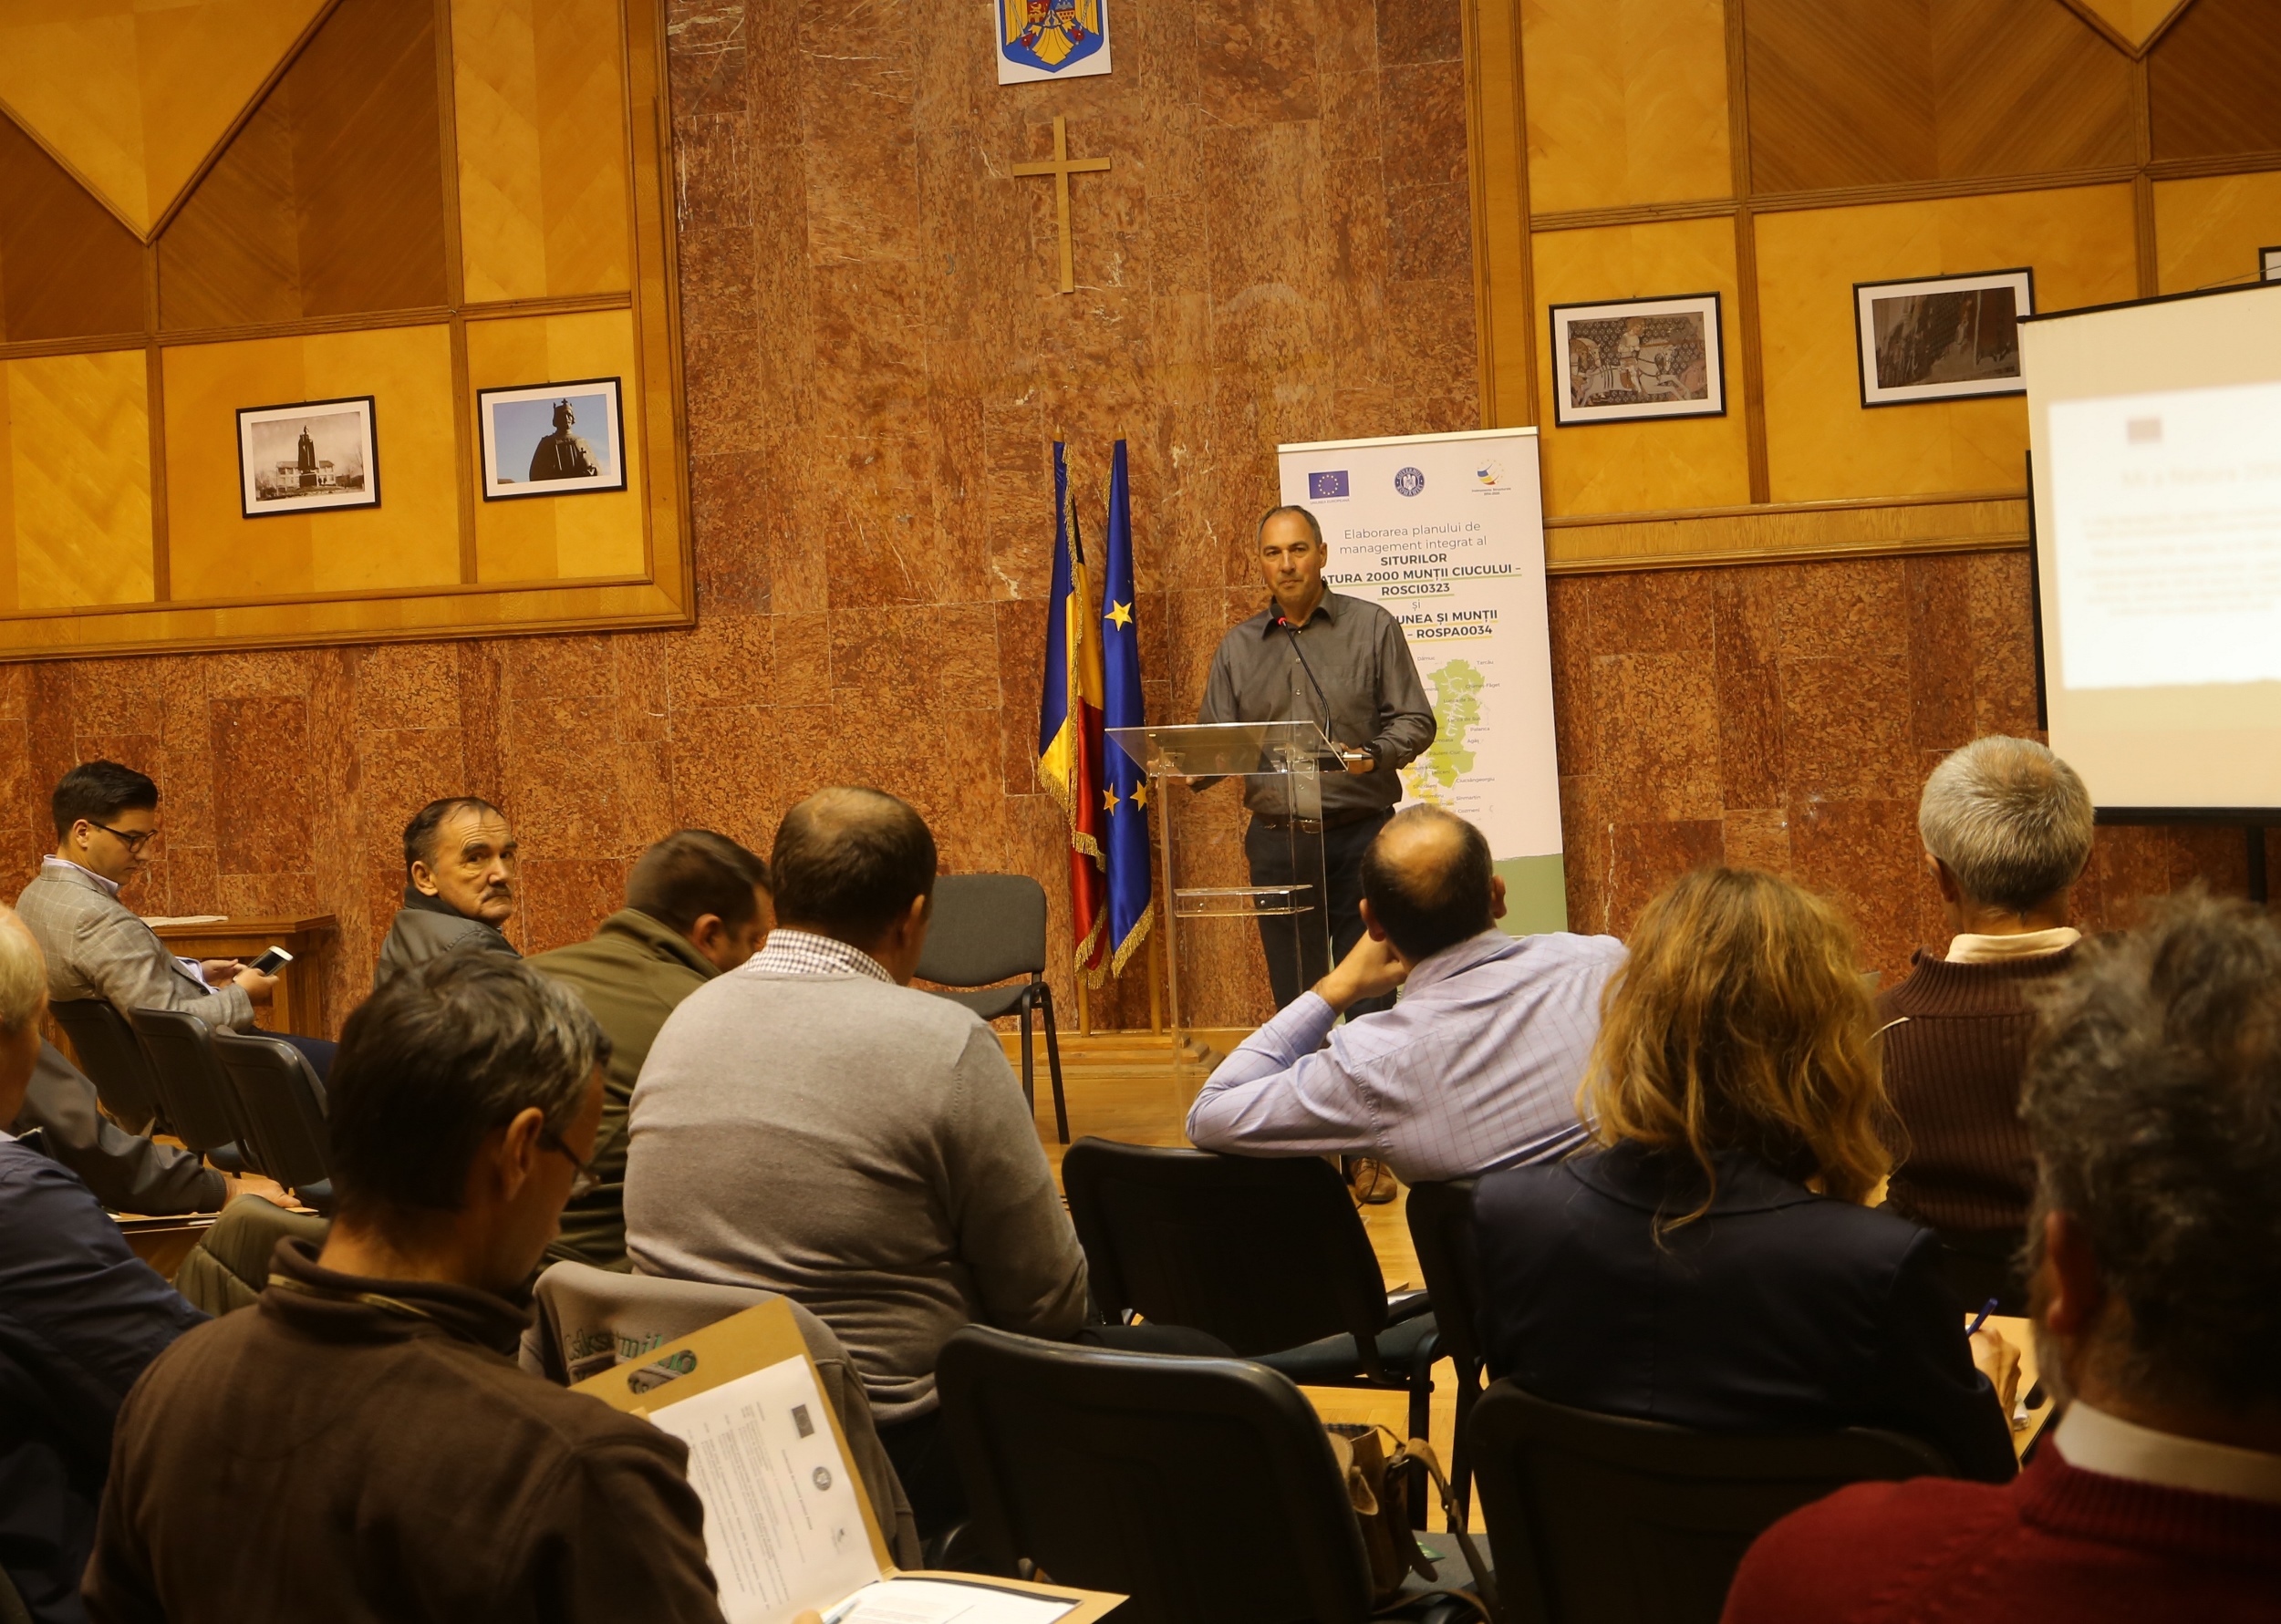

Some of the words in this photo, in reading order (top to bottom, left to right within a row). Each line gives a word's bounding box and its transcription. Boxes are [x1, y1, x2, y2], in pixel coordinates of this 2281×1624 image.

[1344, 528, 1408, 540] Elaborarea
[1413, 522, 1461, 537] planului
[1465, 522, 1481, 532] de
[1340, 540, 1422, 554] management
[1426, 537, 1473, 551] integrat
[1477, 536, 1487, 546] al
[1380, 553, 1447, 566] SITURILOR
[1321, 573, 1363, 584] ATURA
[1367, 571, 1399, 582] 2000
[1403, 568, 1448, 581] MUNȚII
[1452, 564, 1512, 576] CIUCULUI
[1381, 583, 1450, 596] ROSCI0323
[1412, 599, 1421, 611] și
[1396, 614, 1433, 625] UNEA
[1436, 613, 1448, 626] ȘI
[1452, 609, 1498, 623] MUNȚII
[1416, 626, 1493, 638] ROSPA0034
